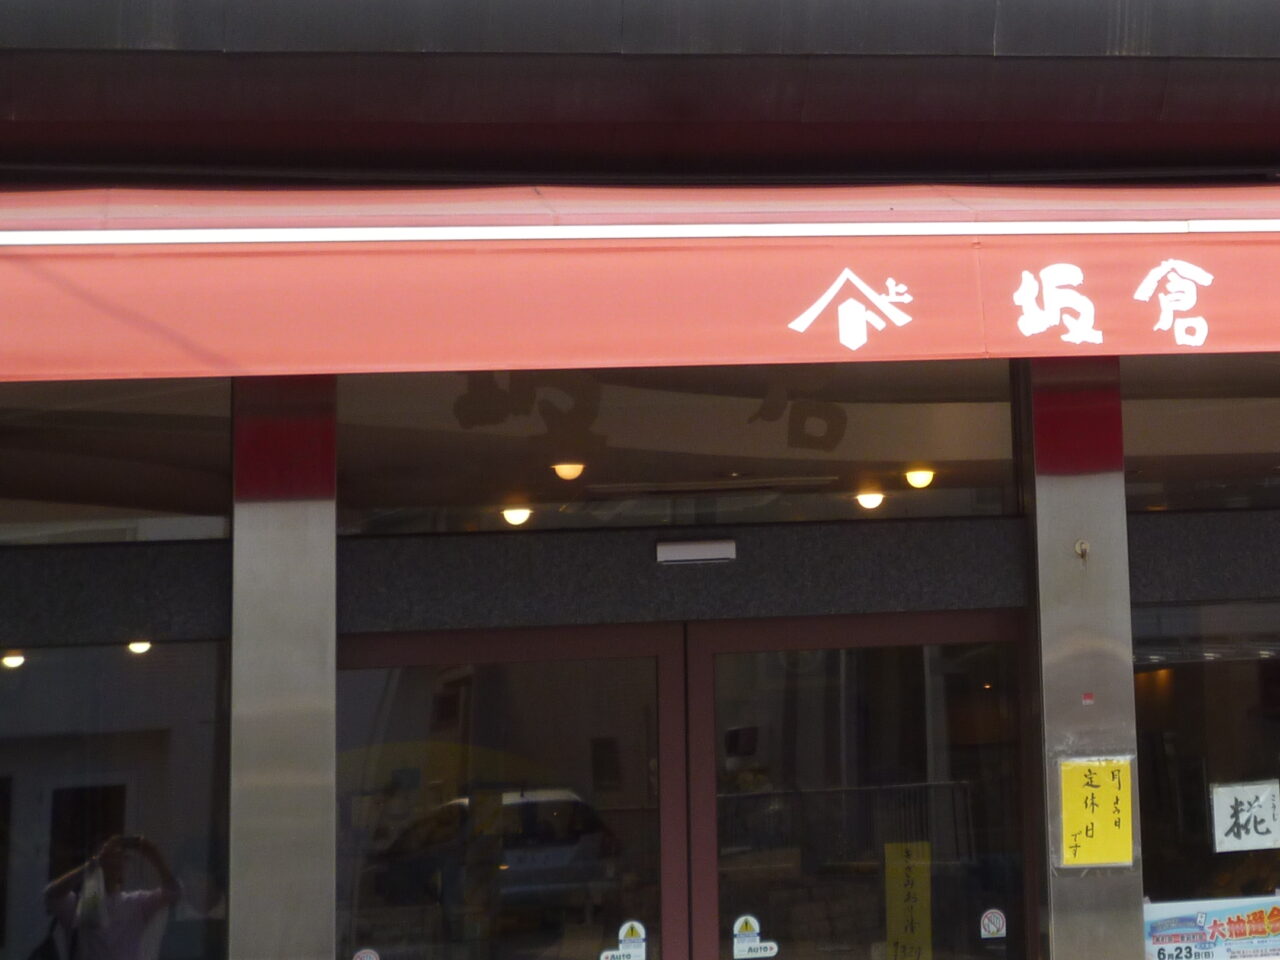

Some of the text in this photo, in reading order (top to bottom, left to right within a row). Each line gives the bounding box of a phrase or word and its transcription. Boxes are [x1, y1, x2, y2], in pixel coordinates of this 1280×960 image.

[1012, 258, 1215, 347] 坂倉
[1083, 768, 1101, 839] 定休日
